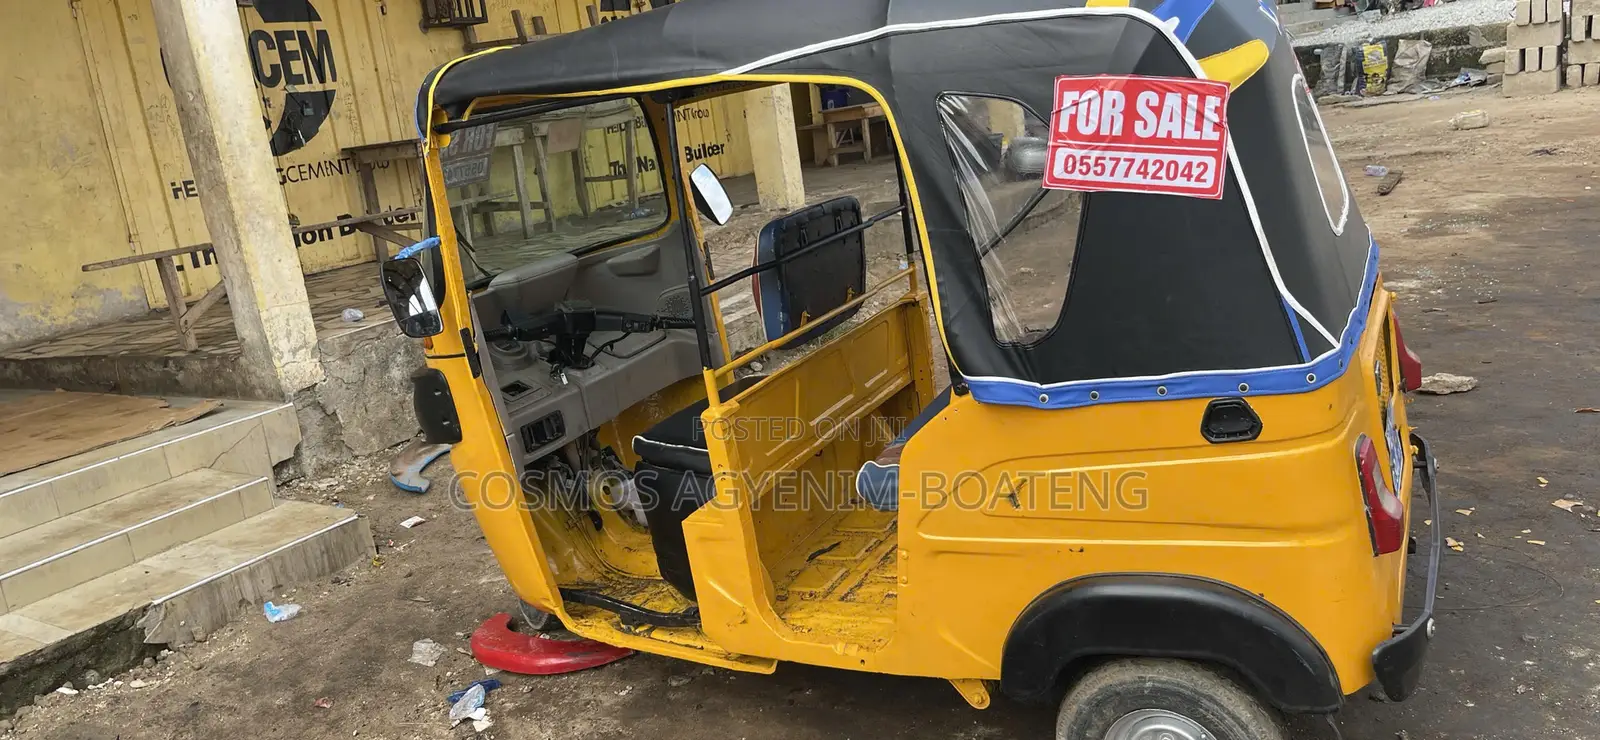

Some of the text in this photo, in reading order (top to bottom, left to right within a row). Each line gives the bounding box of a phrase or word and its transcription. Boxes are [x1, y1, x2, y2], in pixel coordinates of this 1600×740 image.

[248, 29, 338, 88] CEM
[1058, 90, 1222, 141] FOR SALE
[684, 142, 725, 163] Builder
[1063, 154, 1209, 183] 0557742042
[171, 180, 198, 199] HE
[276, 157, 351, 186] GCEMENT
